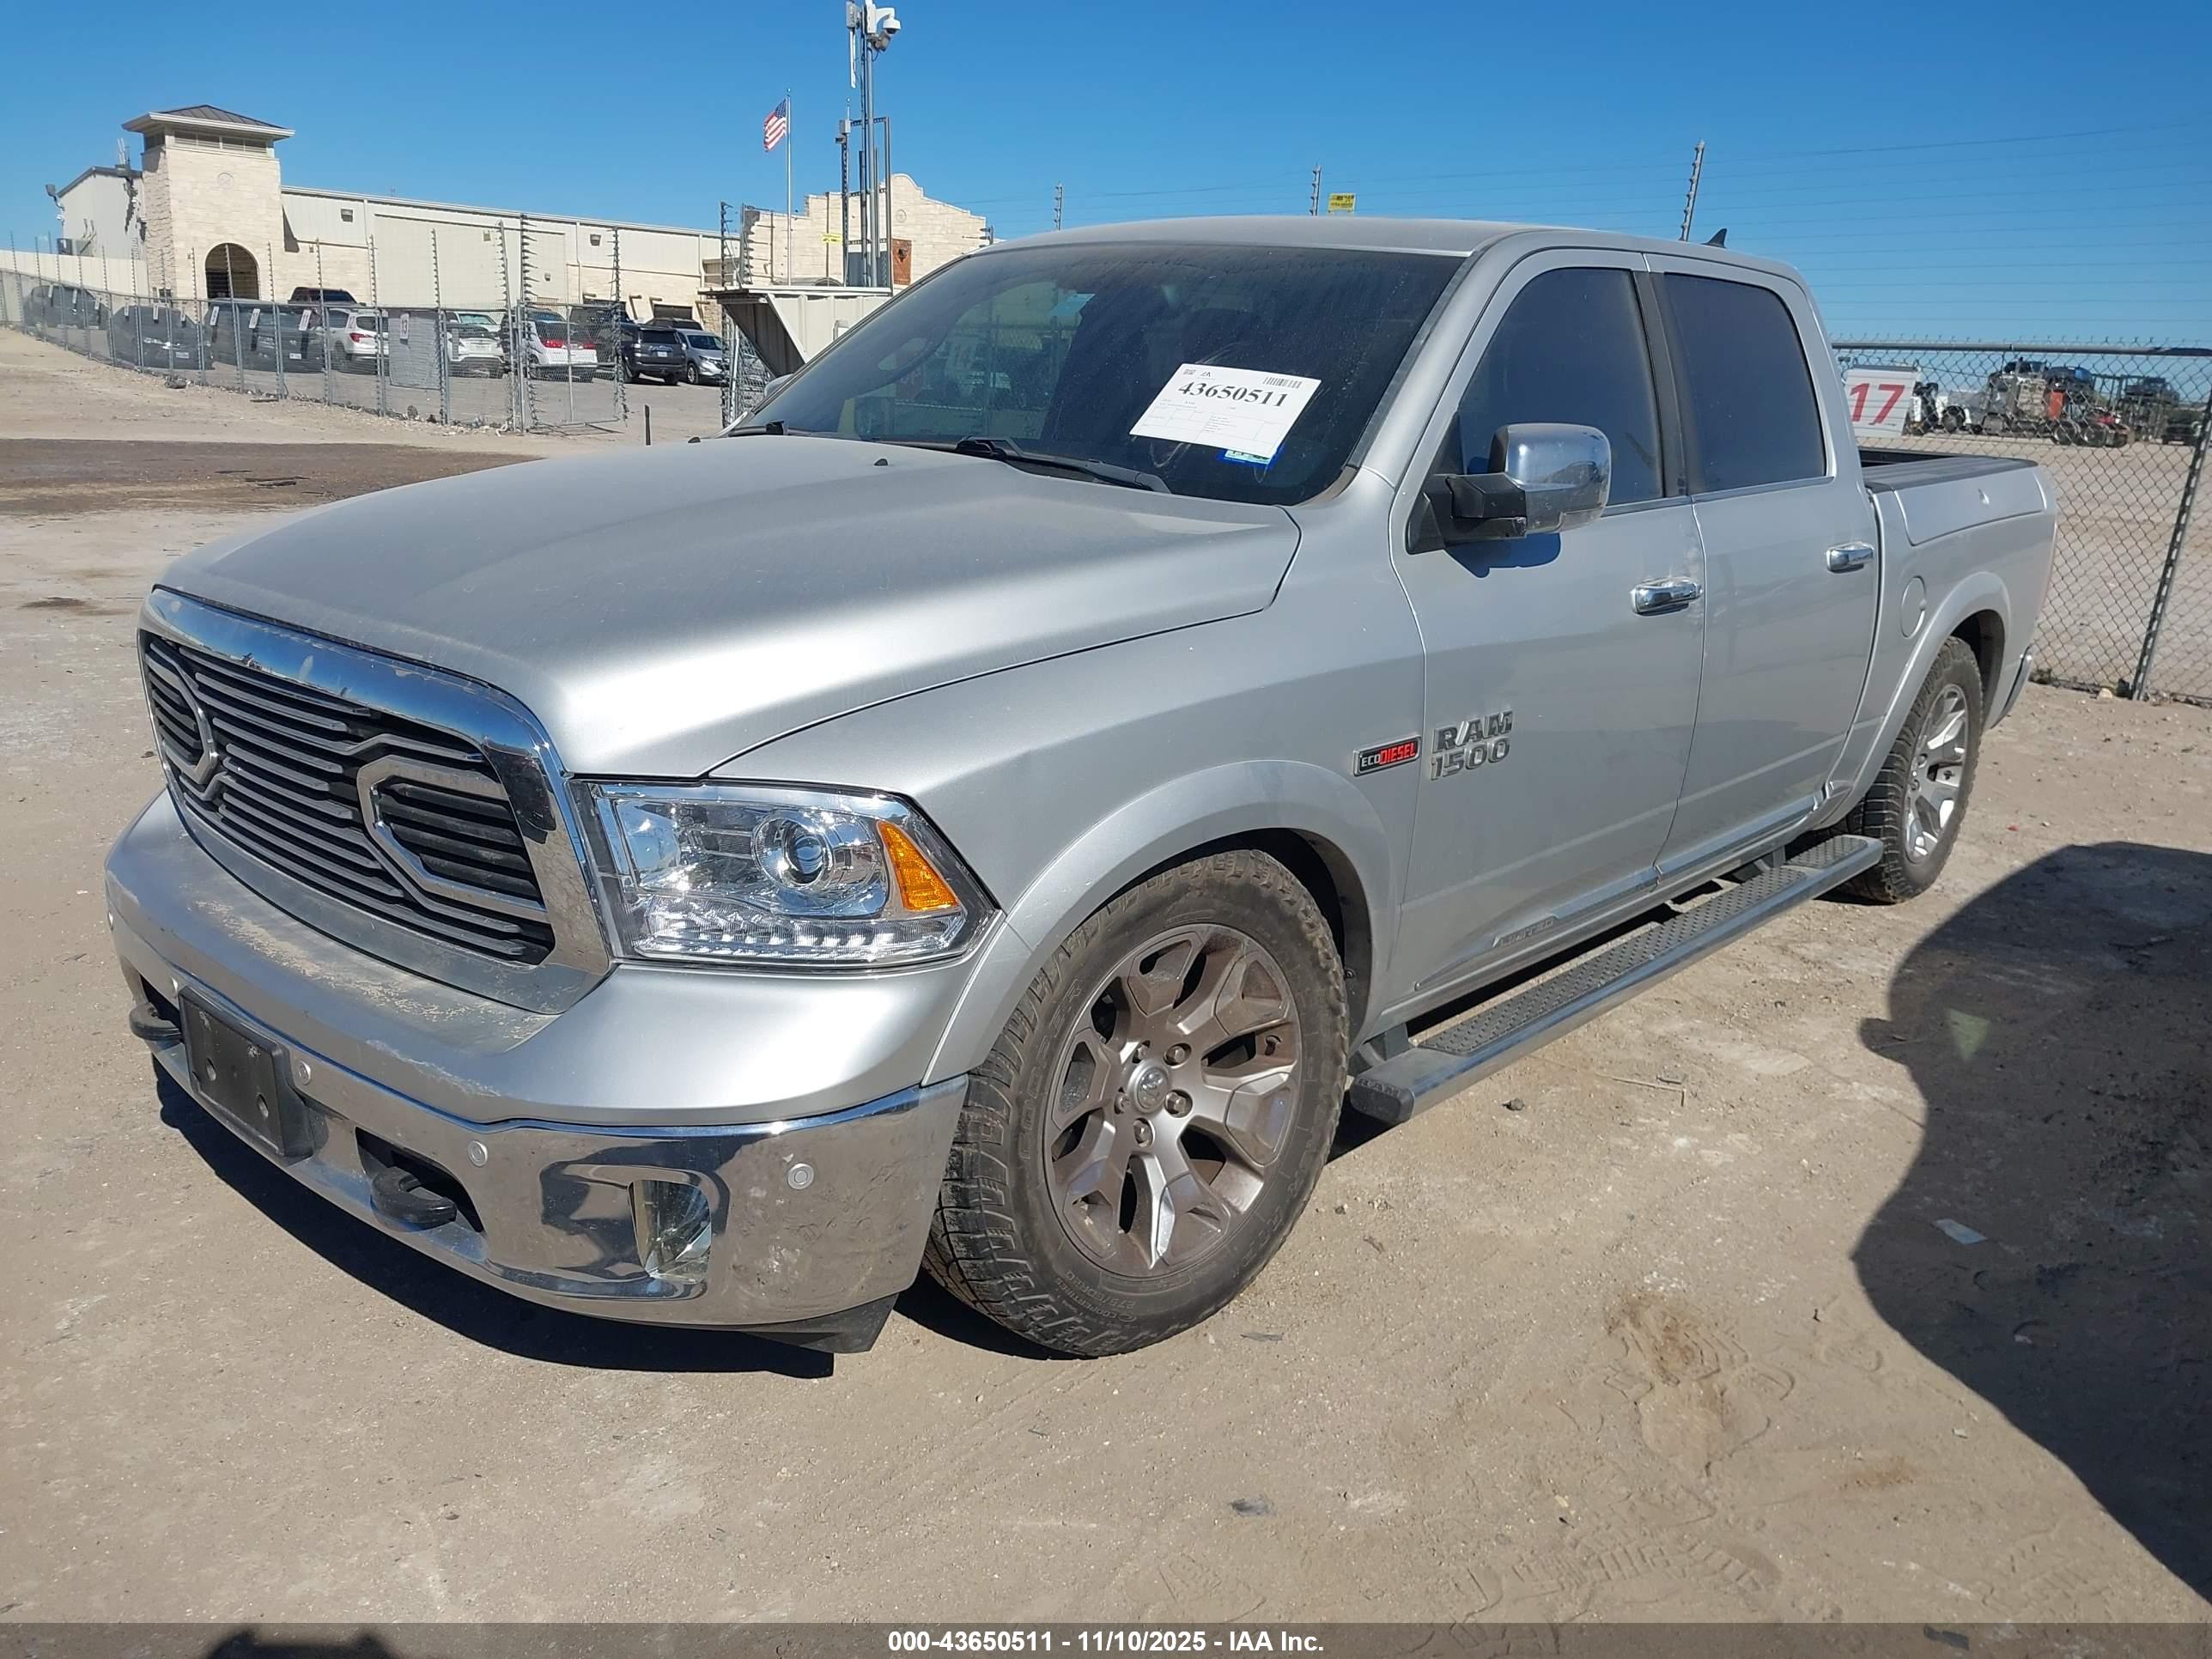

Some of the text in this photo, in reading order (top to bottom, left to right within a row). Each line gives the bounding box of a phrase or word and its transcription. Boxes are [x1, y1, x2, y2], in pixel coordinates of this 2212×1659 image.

[401, 319, 408, 336] 13
[1178, 381, 1288, 407] 43650511
[1850, 383, 1905, 424] 17
[1431, 708, 1514, 753] RAM
[1360, 742, 1417, 768] ECODIESEL
[1430, 736, 1511, 781] 1500
[1018, 978, 1082, 1160] COOPER
